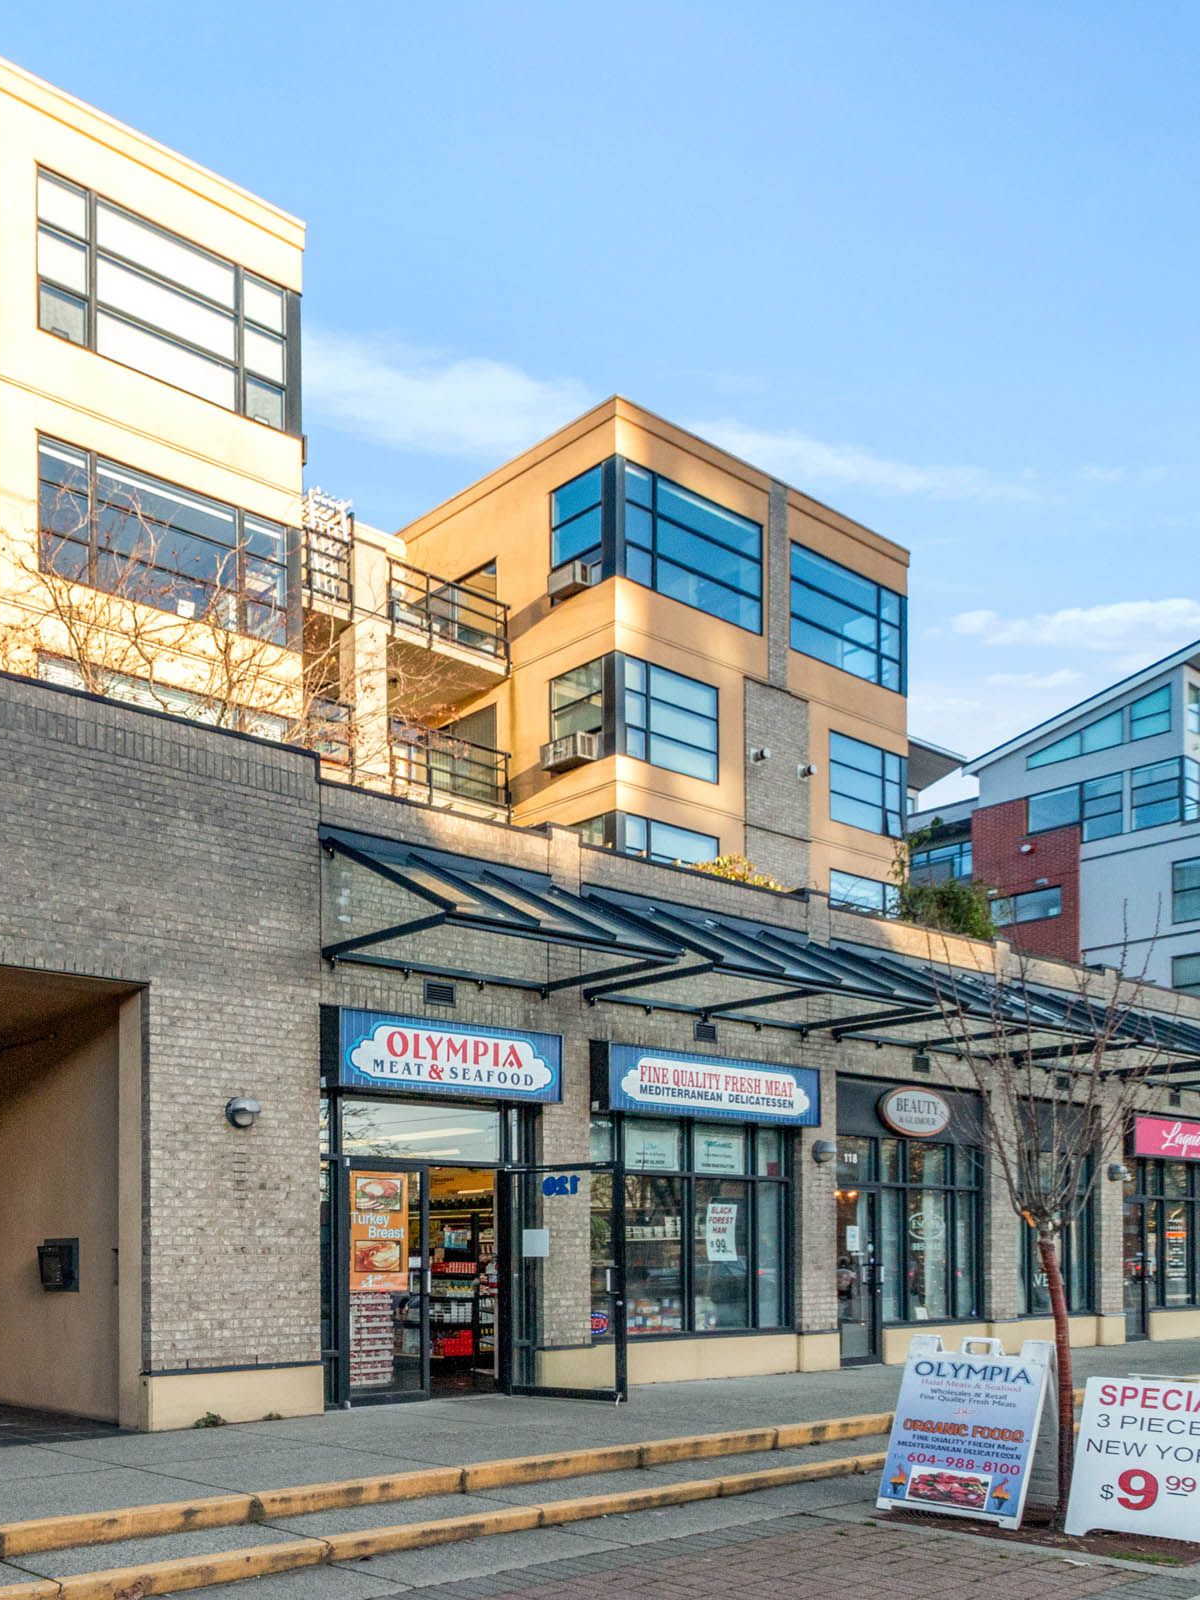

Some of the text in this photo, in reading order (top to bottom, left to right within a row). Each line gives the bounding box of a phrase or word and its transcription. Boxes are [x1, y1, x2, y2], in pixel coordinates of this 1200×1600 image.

[386, 1031, 523, 1069] OLYMPIA
[372, 1058, 534, 1087] MEAT & SEAFOOD
[639, 1065, 794, 1098] FINE QUALITY FRESH MEAT
[639, 1084, 795, 1110] MEDITERRANEAN DELICATESSEN
[895, 1097, 940, 1115] BEAUTY
[843, 1153, 858, 1164] 118
[351, 1211, 390, 1228] Turkey
[711, 1206, 733, 1215] BLACK
[708, 1216, 734, 1225] FOREST
[368, 1226, 405, 1239] Breast
[712, 1226, 728, 1234] HAM
[915, 1361, 1031, 1384] OLYMPIA
[1097, 1413, 1111, 1428] 3
[903, 1418, 1025, 1443] ORGANIC FOODS
[931, 1436, 965, 1446] QUALITY
[1086, 1438, 1148, 1457] NEW
[906, 1452, 1020, 1475] 604-988-8100
[1100, 1468, 1197, 1511] $ 9 99
